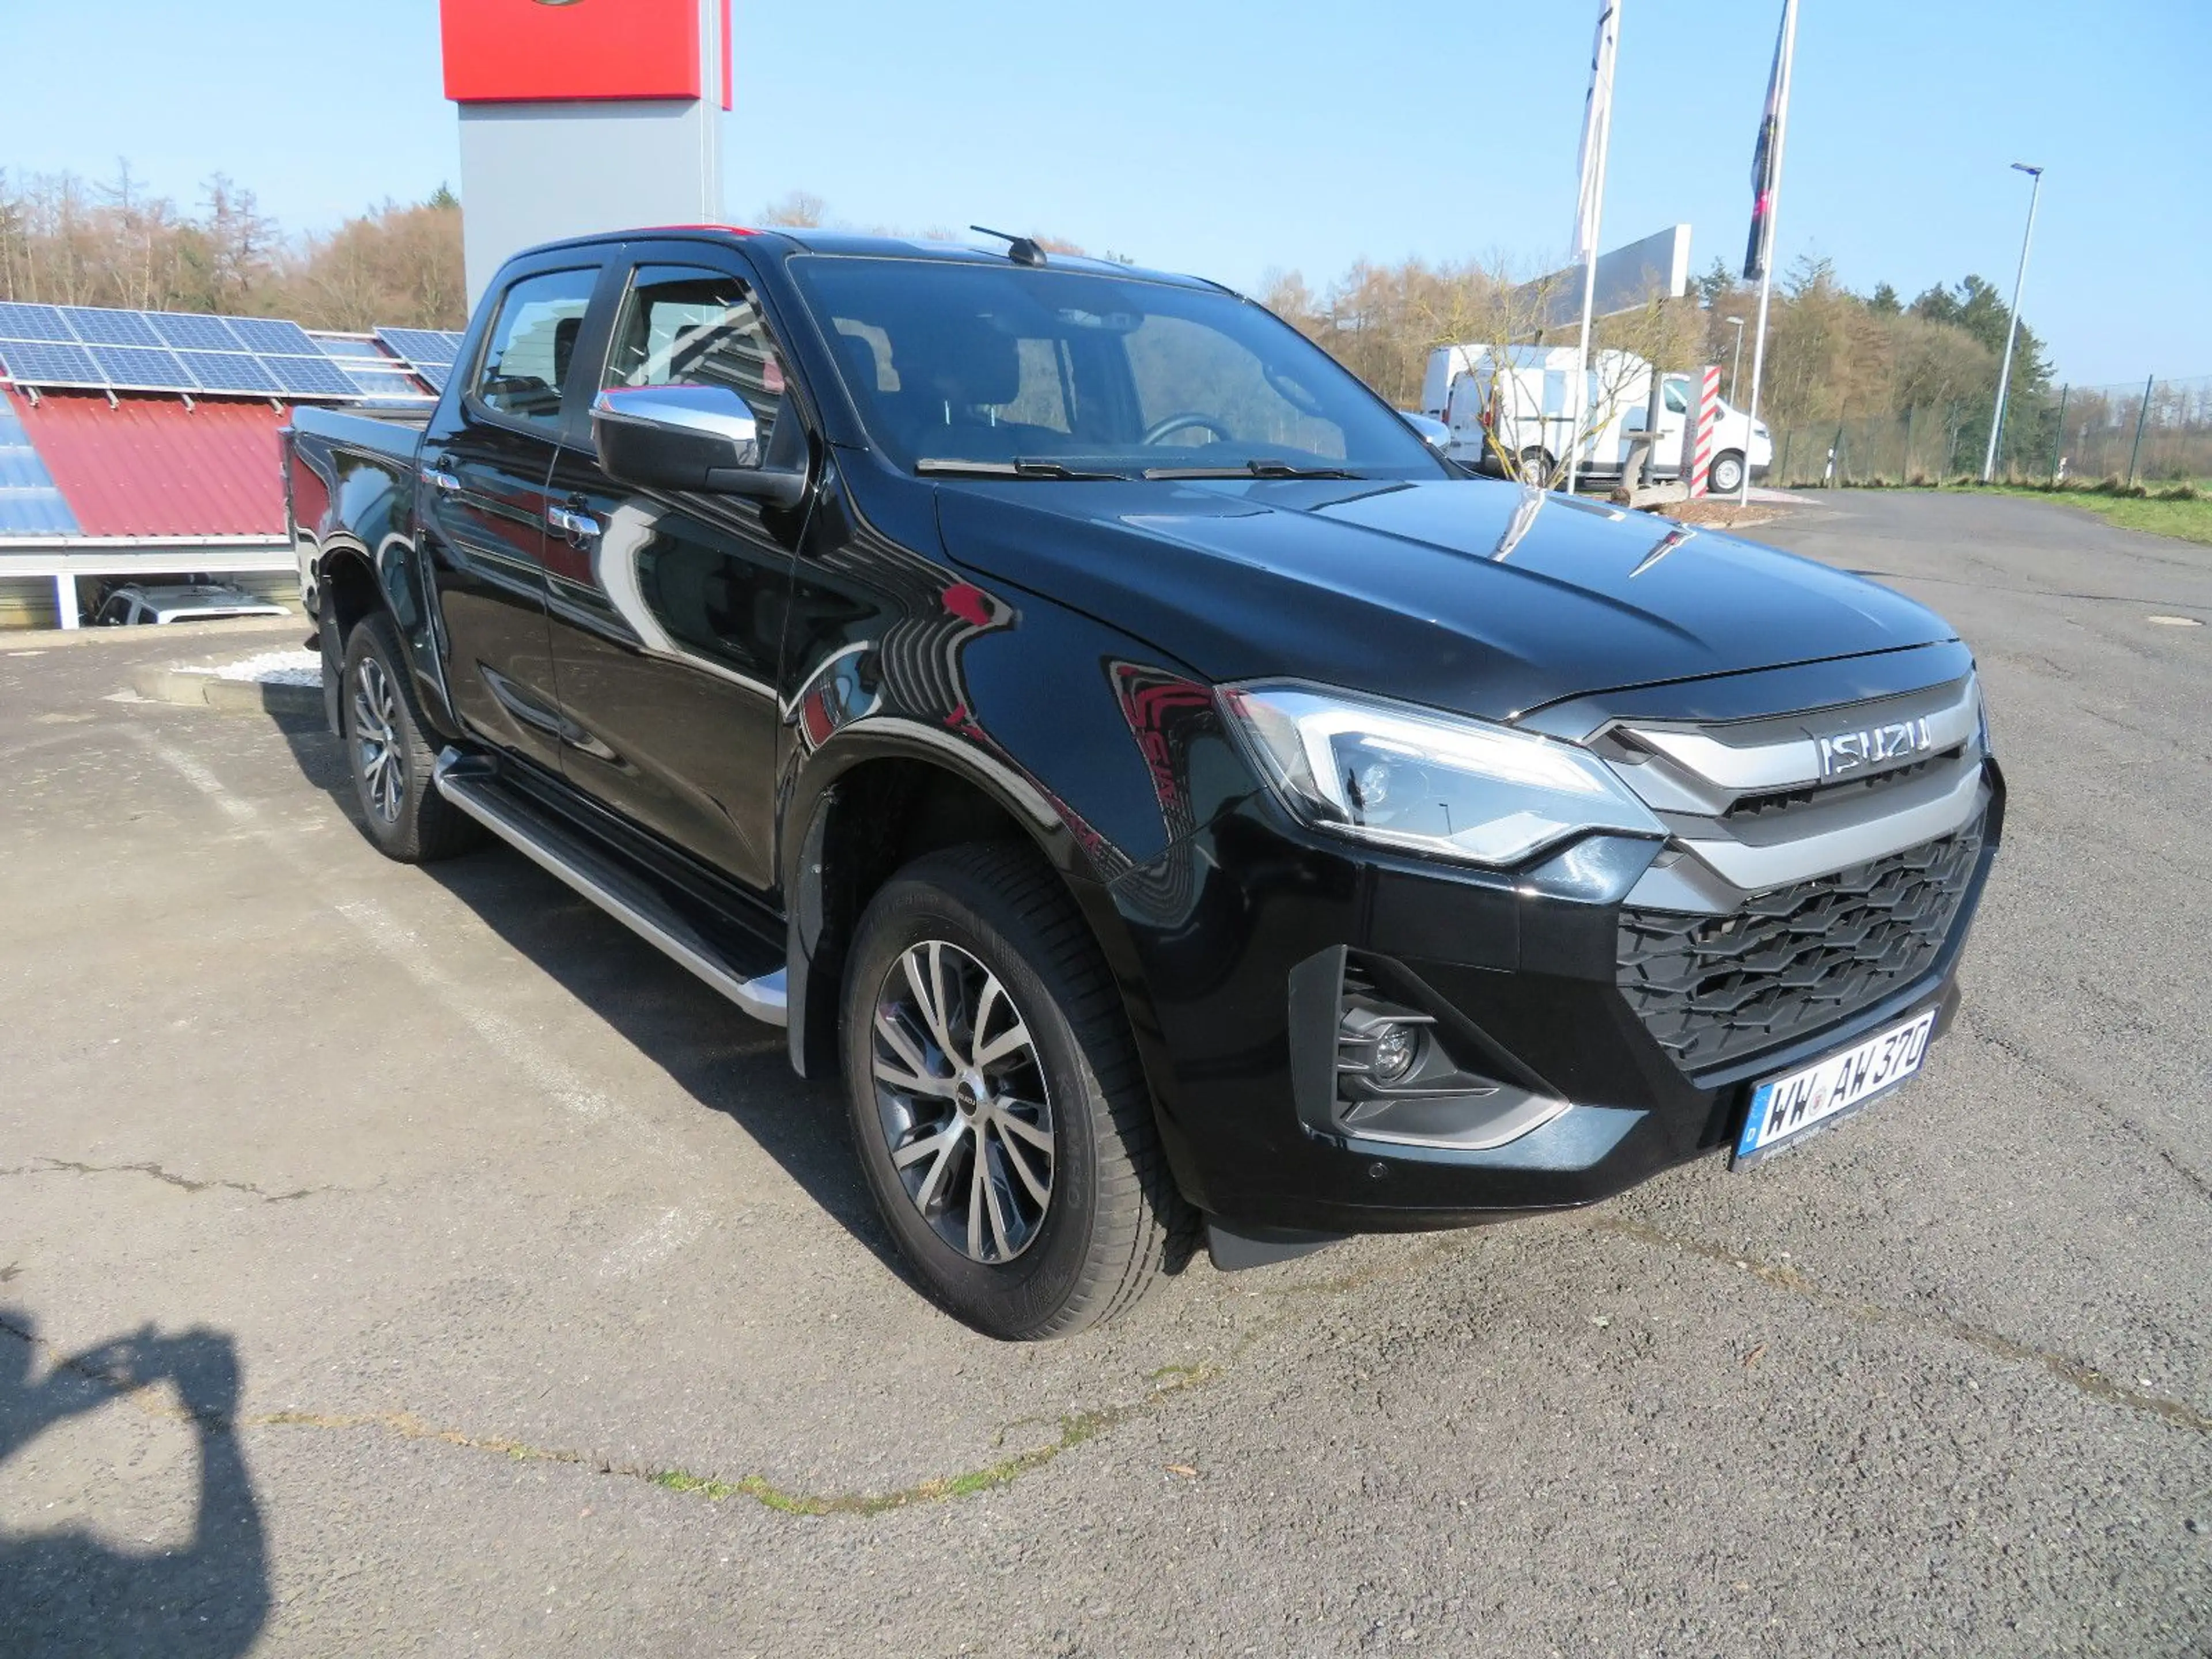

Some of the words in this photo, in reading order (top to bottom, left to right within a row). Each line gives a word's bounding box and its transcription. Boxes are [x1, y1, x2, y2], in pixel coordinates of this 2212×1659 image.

[1819, 717, 1930, 776] ISUZU
[1766, 1073, 1817, 1137] WW
[1828, 1045, 1876, 1108] AW
[1873, 1020, 1929, 1084] 370
